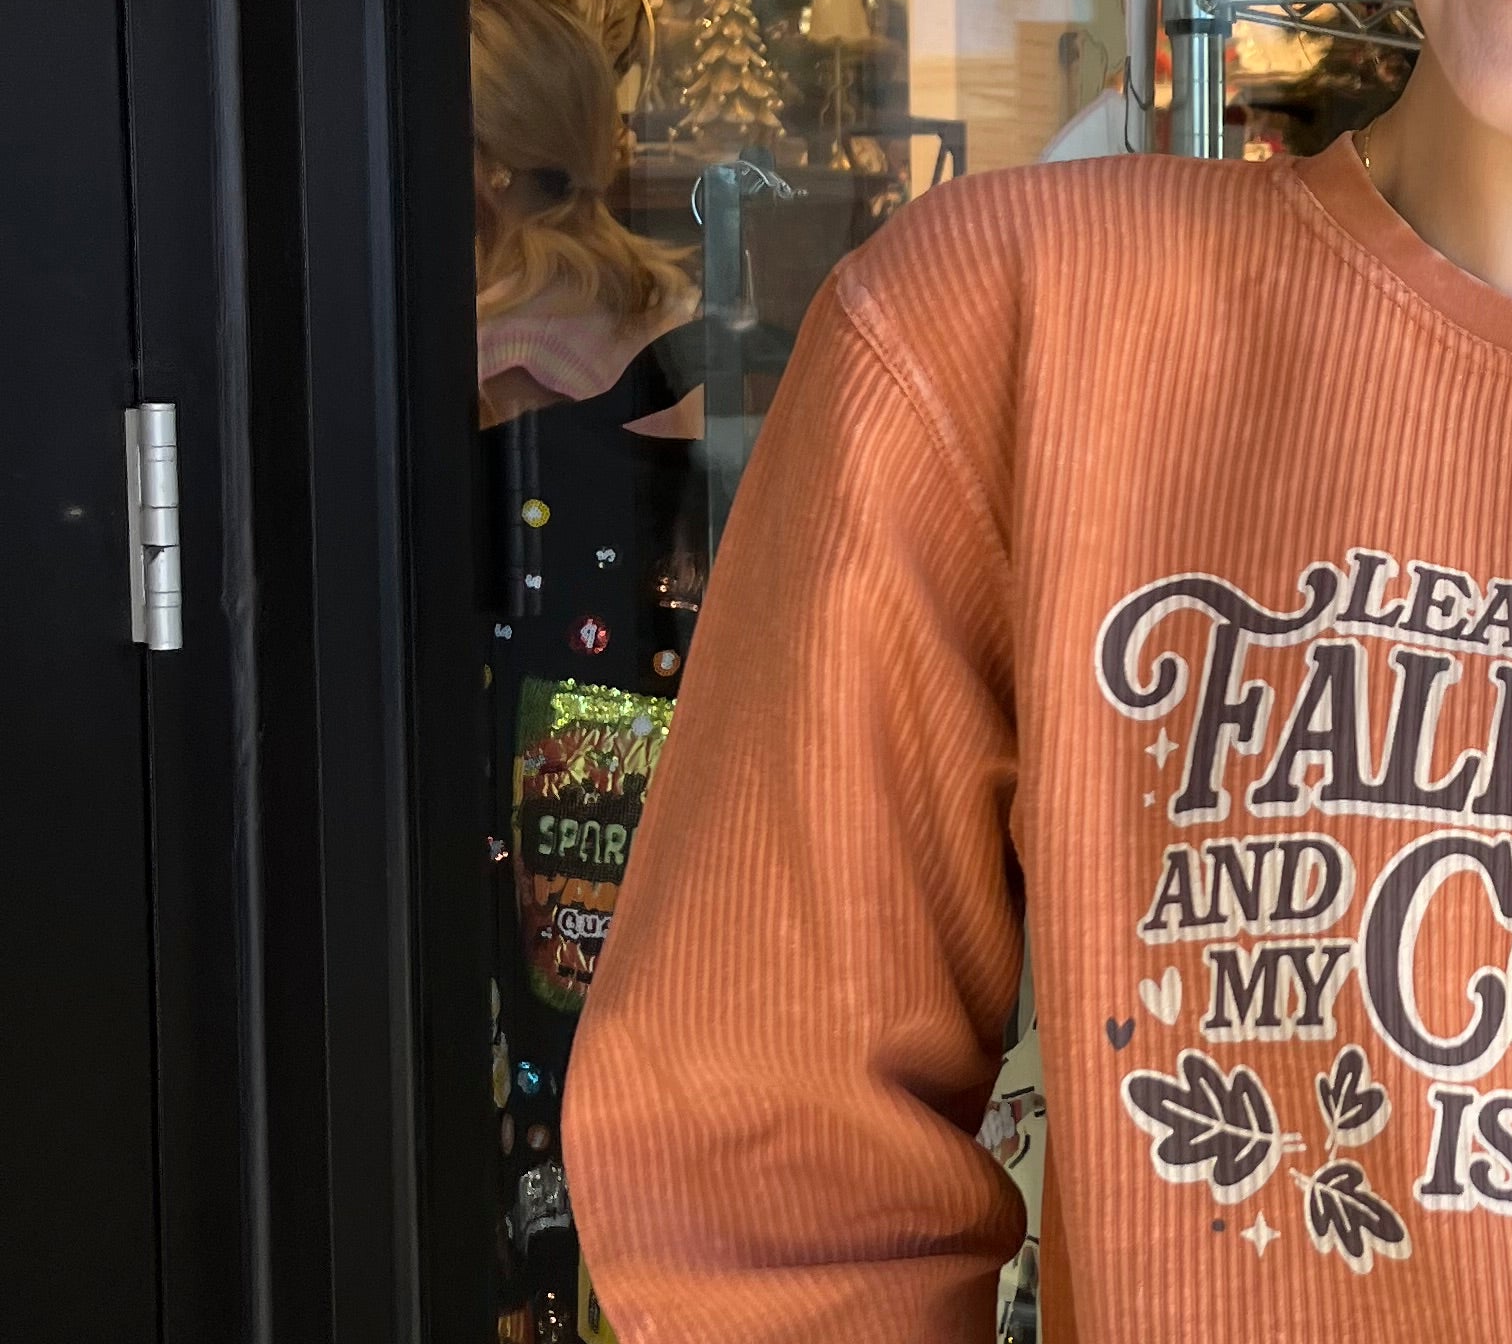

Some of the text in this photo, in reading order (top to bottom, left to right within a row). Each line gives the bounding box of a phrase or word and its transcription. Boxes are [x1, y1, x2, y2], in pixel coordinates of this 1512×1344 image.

[538, 814, 638, 865] SPAR
[1140, 835, 1354, 939] AND
[1202, 939, 1352, 1037] MY
